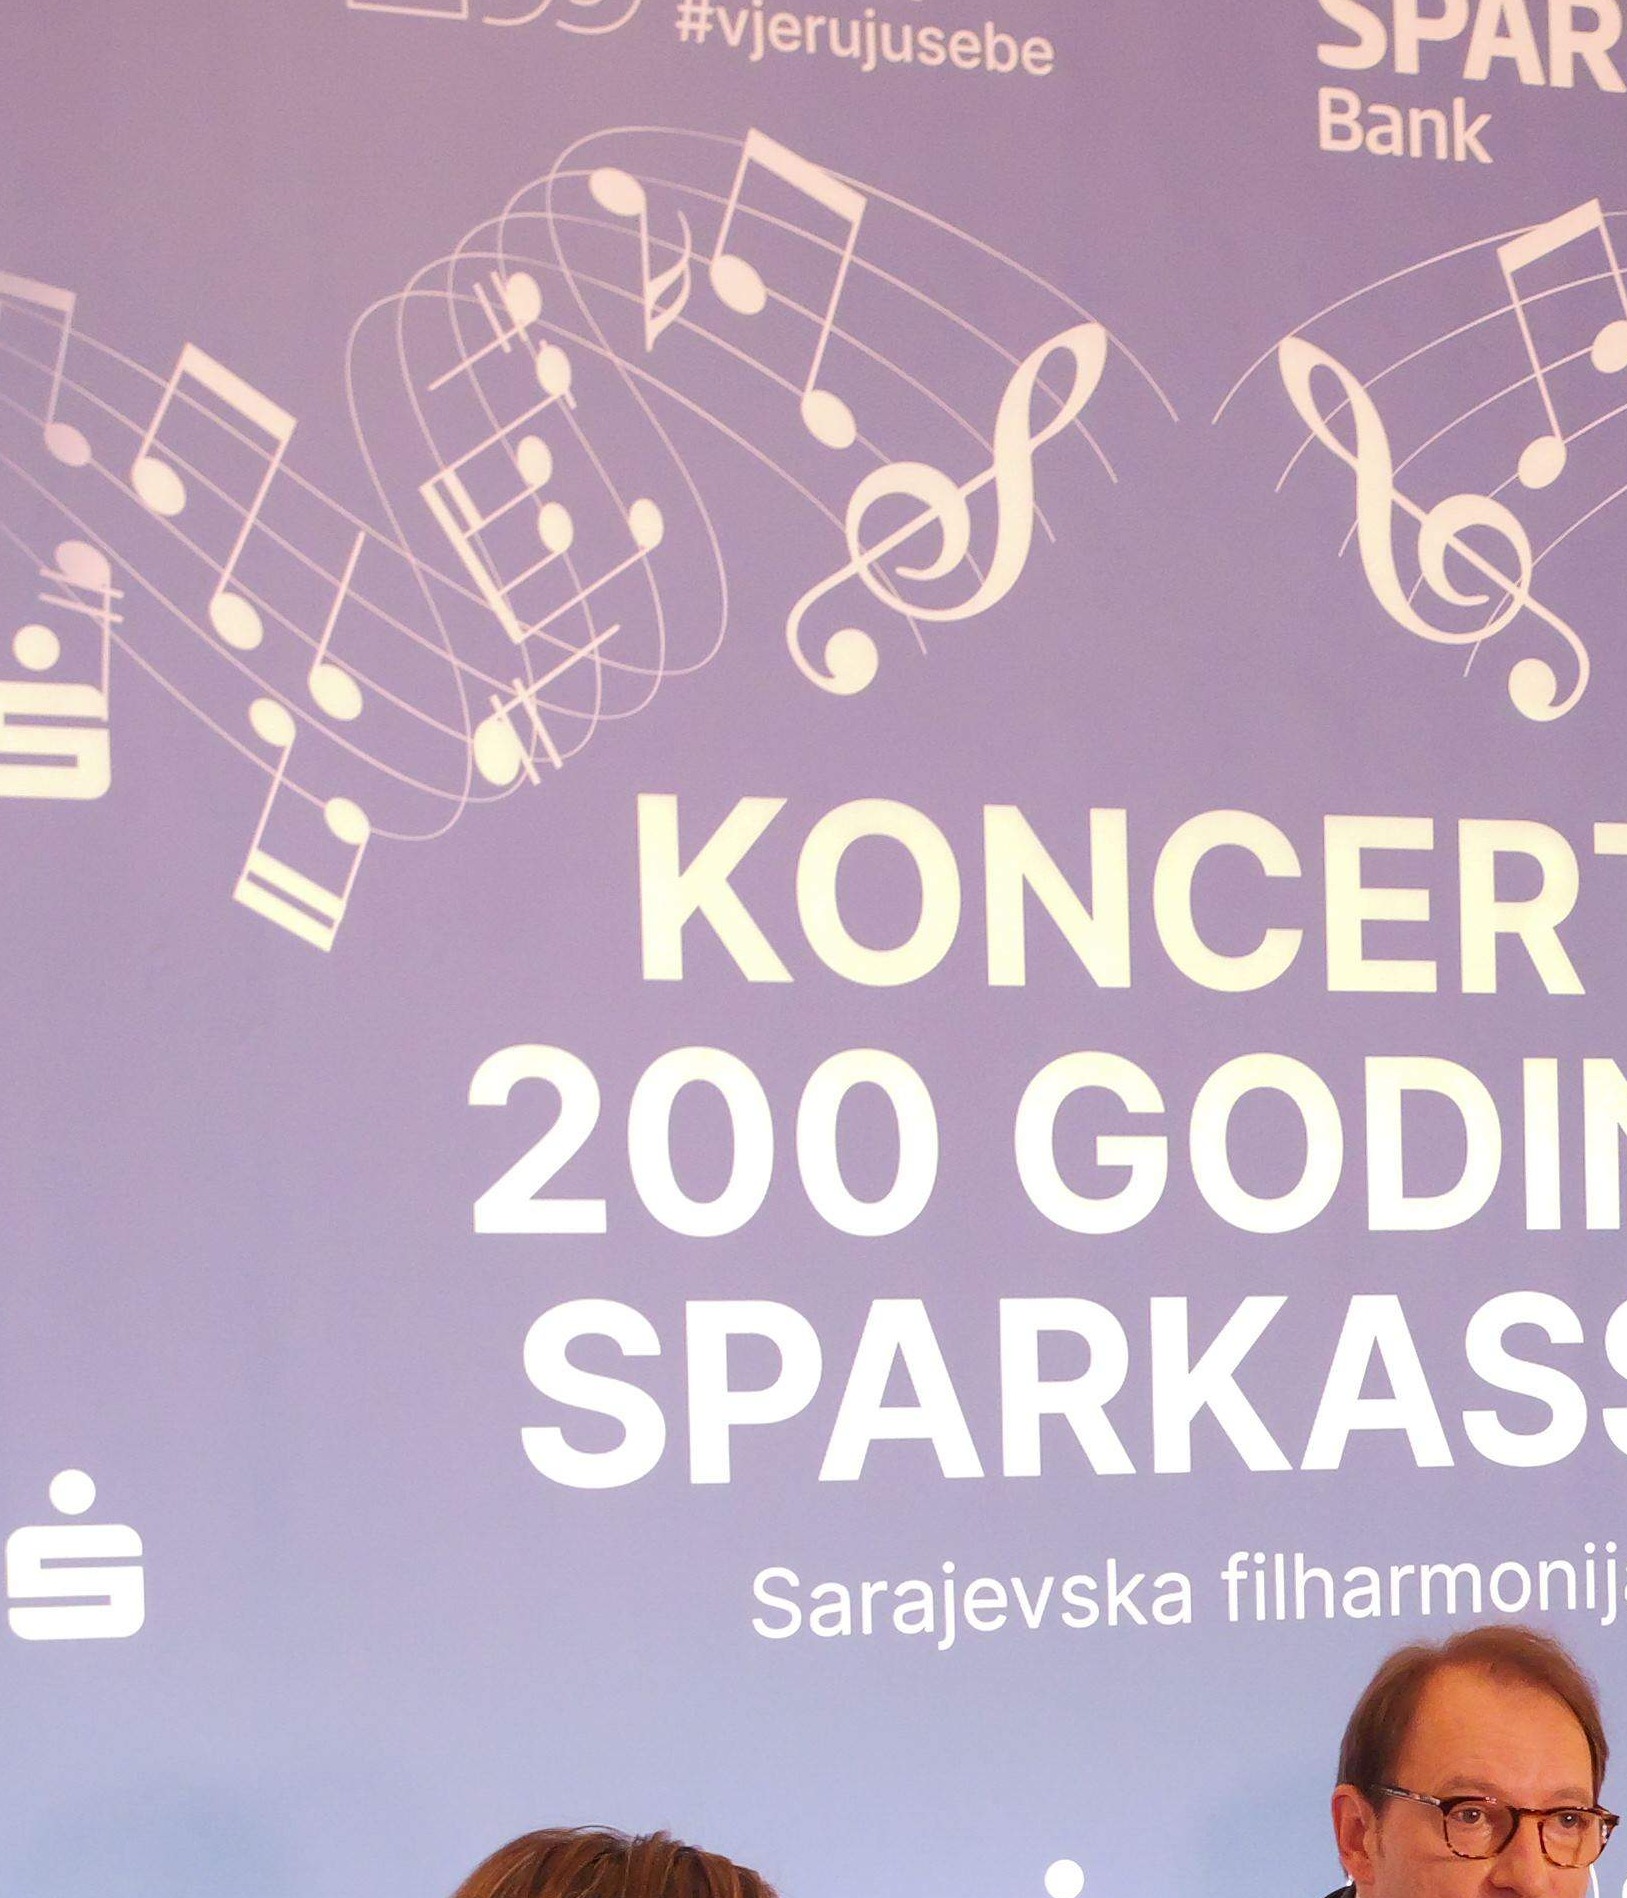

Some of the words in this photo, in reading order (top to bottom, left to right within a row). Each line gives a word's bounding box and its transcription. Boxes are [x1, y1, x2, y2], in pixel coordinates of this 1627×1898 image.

[675, 1, 1055, 76] #vjerujusebe
[1318, 87, 1493, 164] Bank
[467, 1044, 939, 1238] 200
[751, 1558, 1193, 1651] Sarajevska
